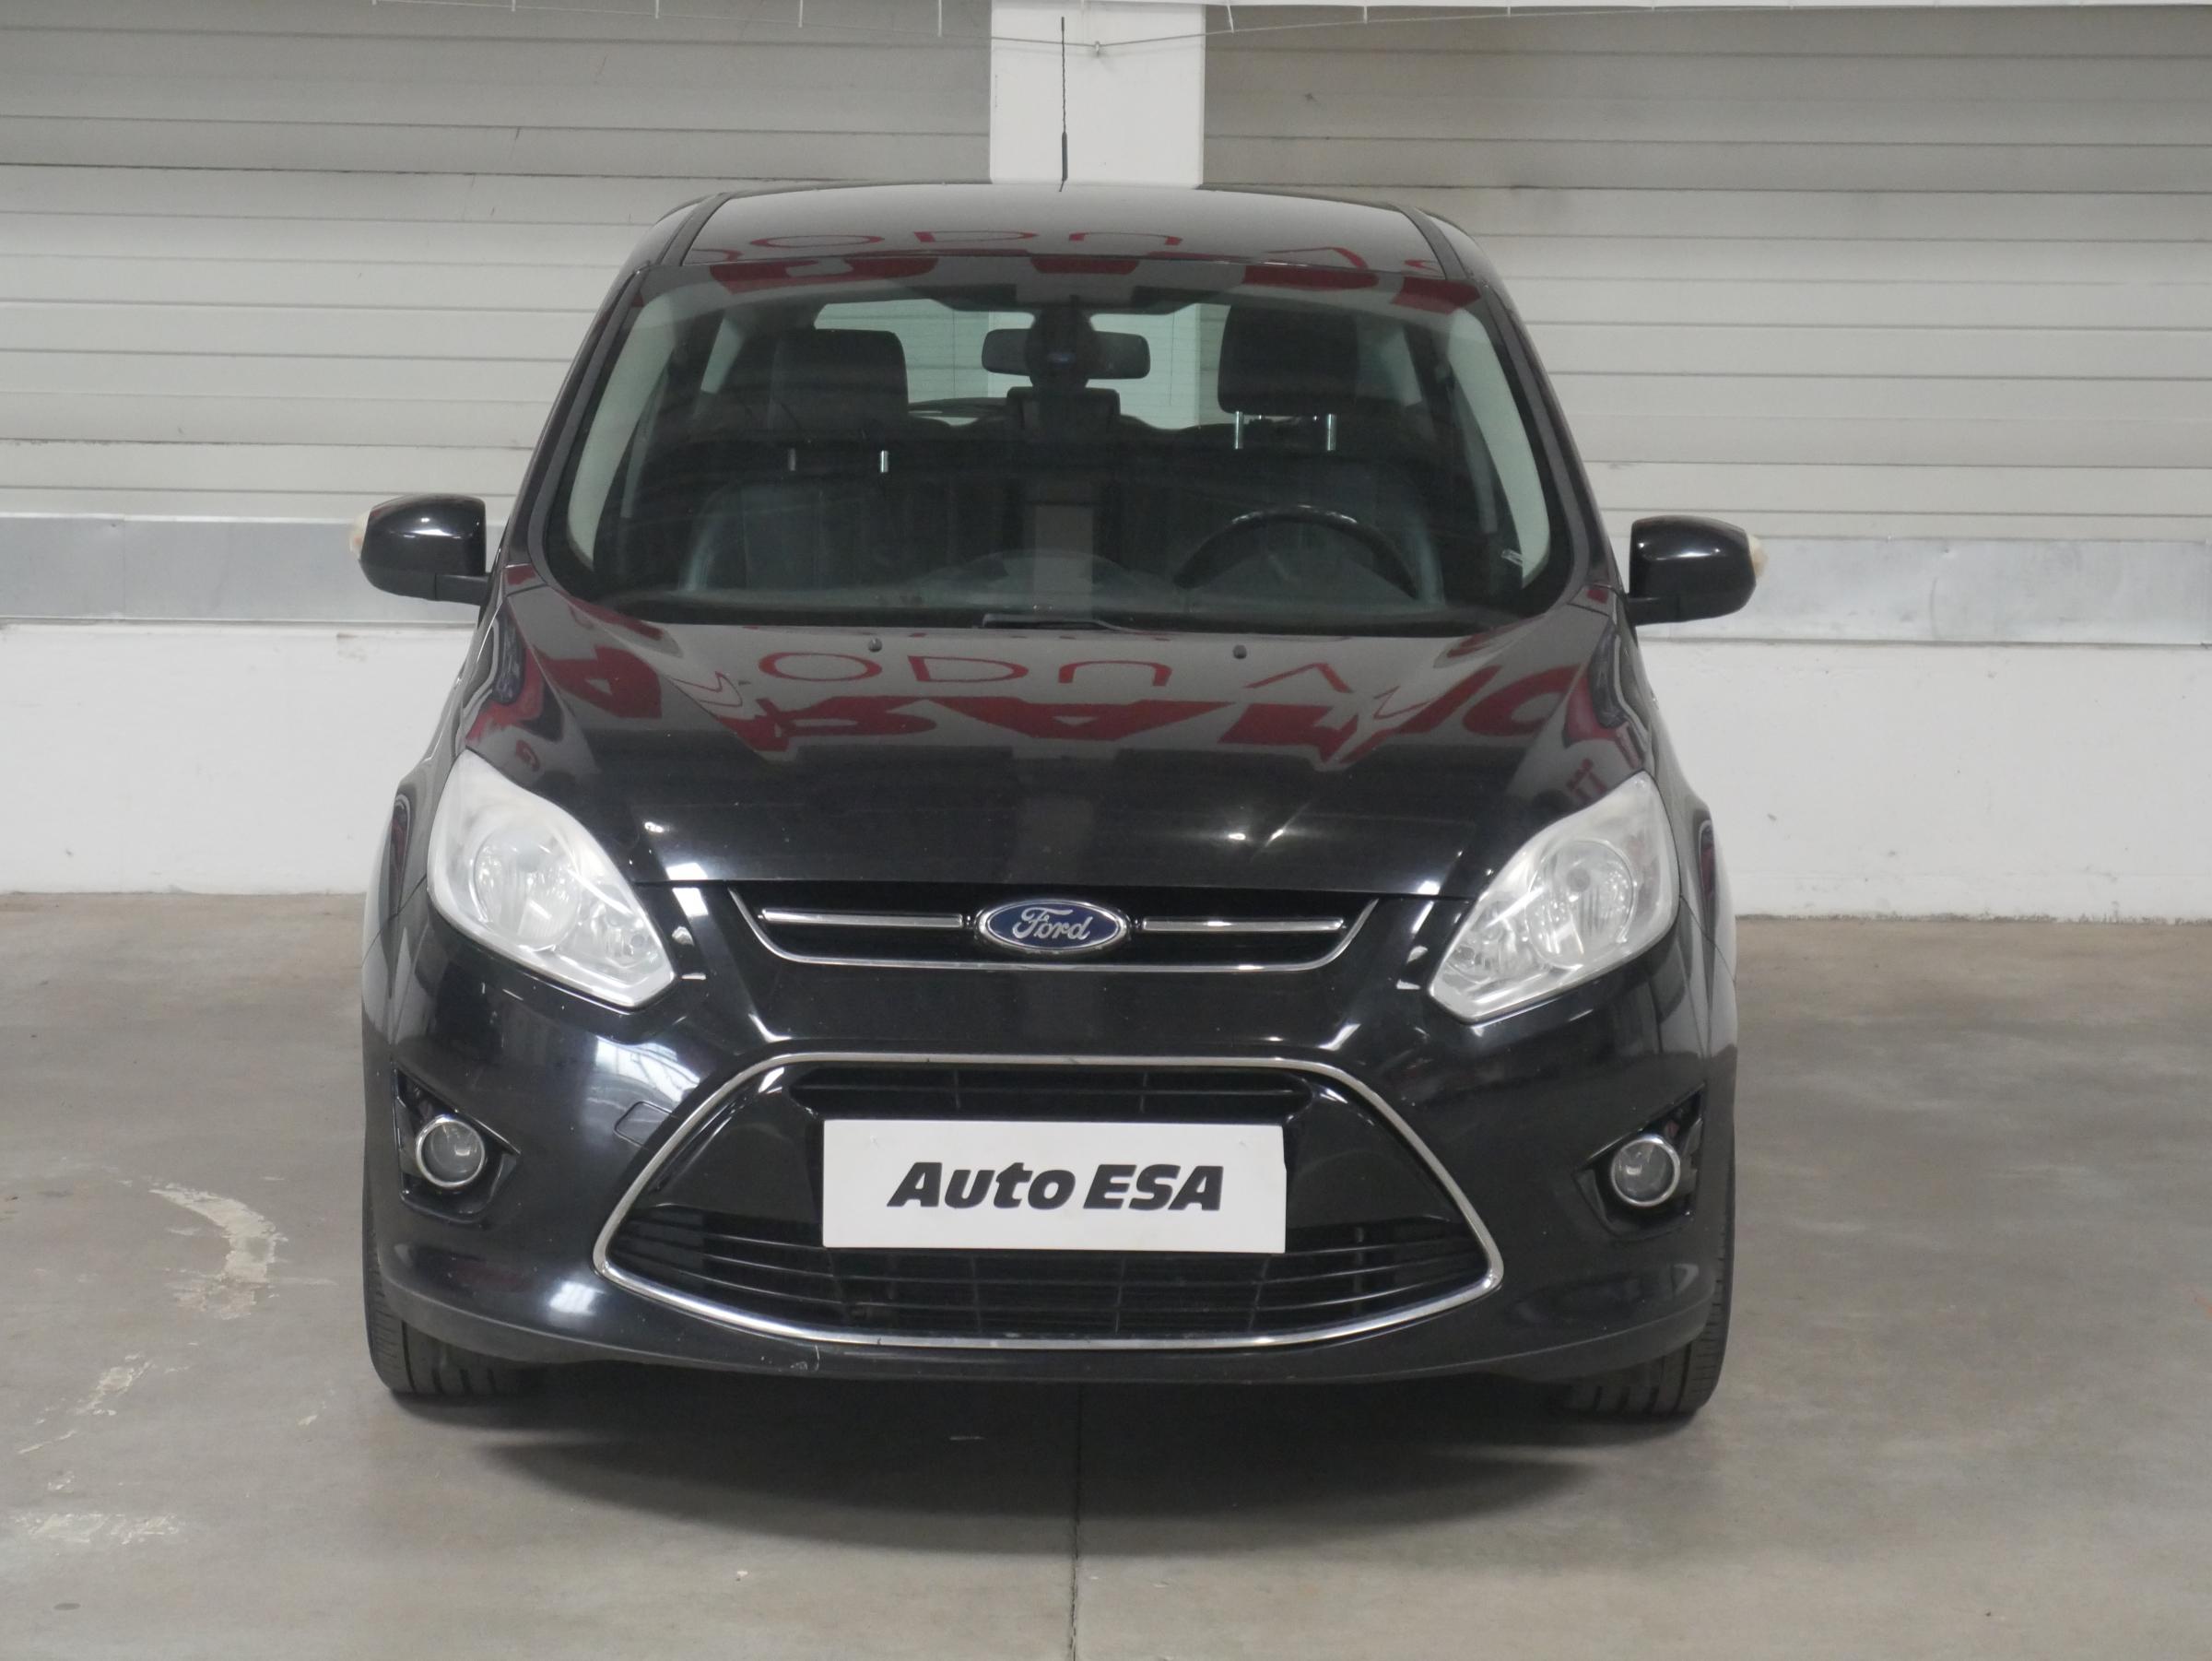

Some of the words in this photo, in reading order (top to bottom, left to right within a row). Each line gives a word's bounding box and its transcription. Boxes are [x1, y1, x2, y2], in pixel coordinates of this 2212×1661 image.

[1012, 906, 1094, 940] Ford
[886, 1161, 1077, 1209] Auto
[1082, 1164, 1224, 1211] ESA
